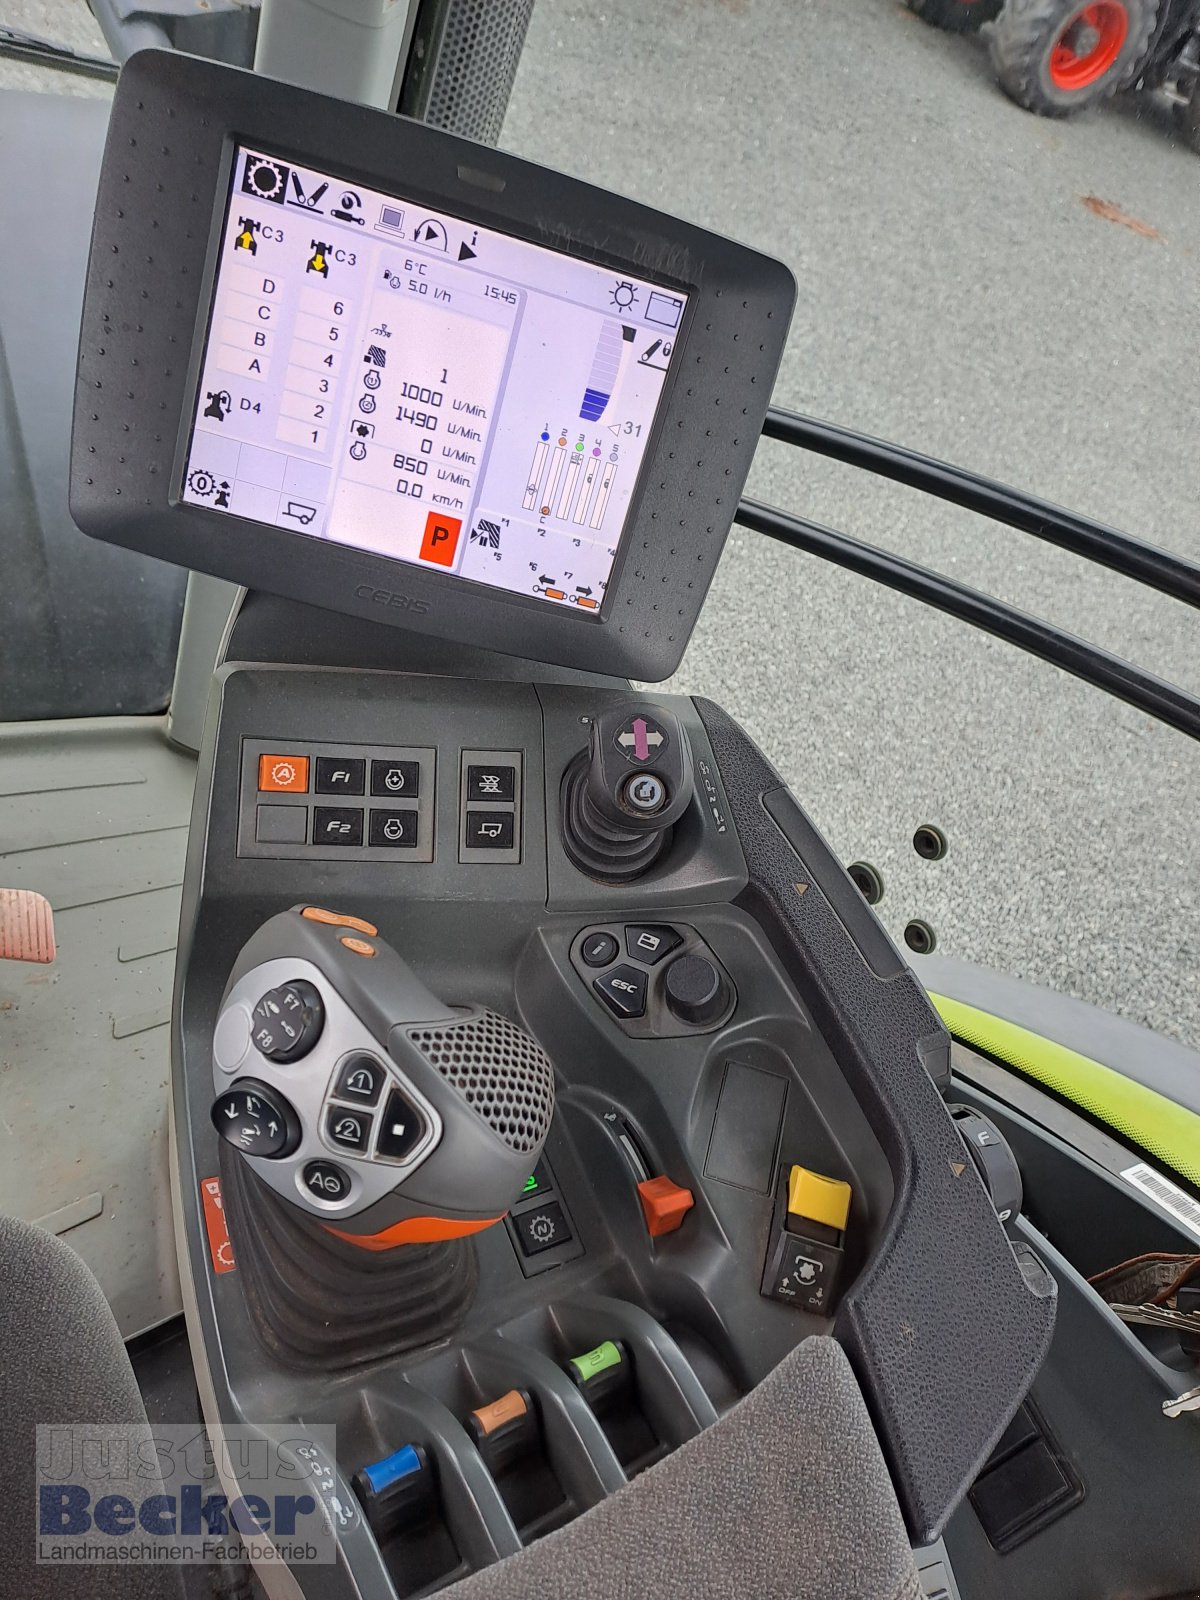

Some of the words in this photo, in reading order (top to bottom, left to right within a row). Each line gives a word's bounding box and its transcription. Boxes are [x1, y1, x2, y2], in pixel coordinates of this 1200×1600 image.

[261, 225, 285, 243] C3
[334, 250, 357, 266] C3
[262, 278, 276, 294] D
[484, 285, 518, 305] 15:45
[258, 305, 271, 320] C
[333, 301, 344, 315] 6
[254, 332, 266, 346] B
[328, 327, 339, 341] 5
[248, 359, 261, 373] A
[323, 354, 334, 367] 4
[440, 368, 448, 384] 1
[318, 379, 329, 393] 3
[400, 382, 443, 407] 1000
[239, 397, 262, 414] D4
[313, 405, 324, 418] 2
[395, 406, 438, 431] 1490
[311, 430, 319, 443] 1
[560, 428, 568, 437] 2
[623, 421, 642, 438] 31
[578, 433, 586, 442] 3
[595, 438, 602, 447] 4
[420, 439, 433, 454] 0
[393, 454, 428, 476] 850
[396, 479, 423, 498] 0.0
[432, 493, 463, 510] km/h
[431, 525, 449, 547] P
[331, 771, 350, 783] F1
[326, 820, 351, 833] F2
[611, 978, 638, 994] ESC
[283, 993, 300, 1011] F7
[256, 1029, 273, 1047] F8
[778, 1287, 796, 1296] OFF
[808, 1297, 822, 1307] ON
